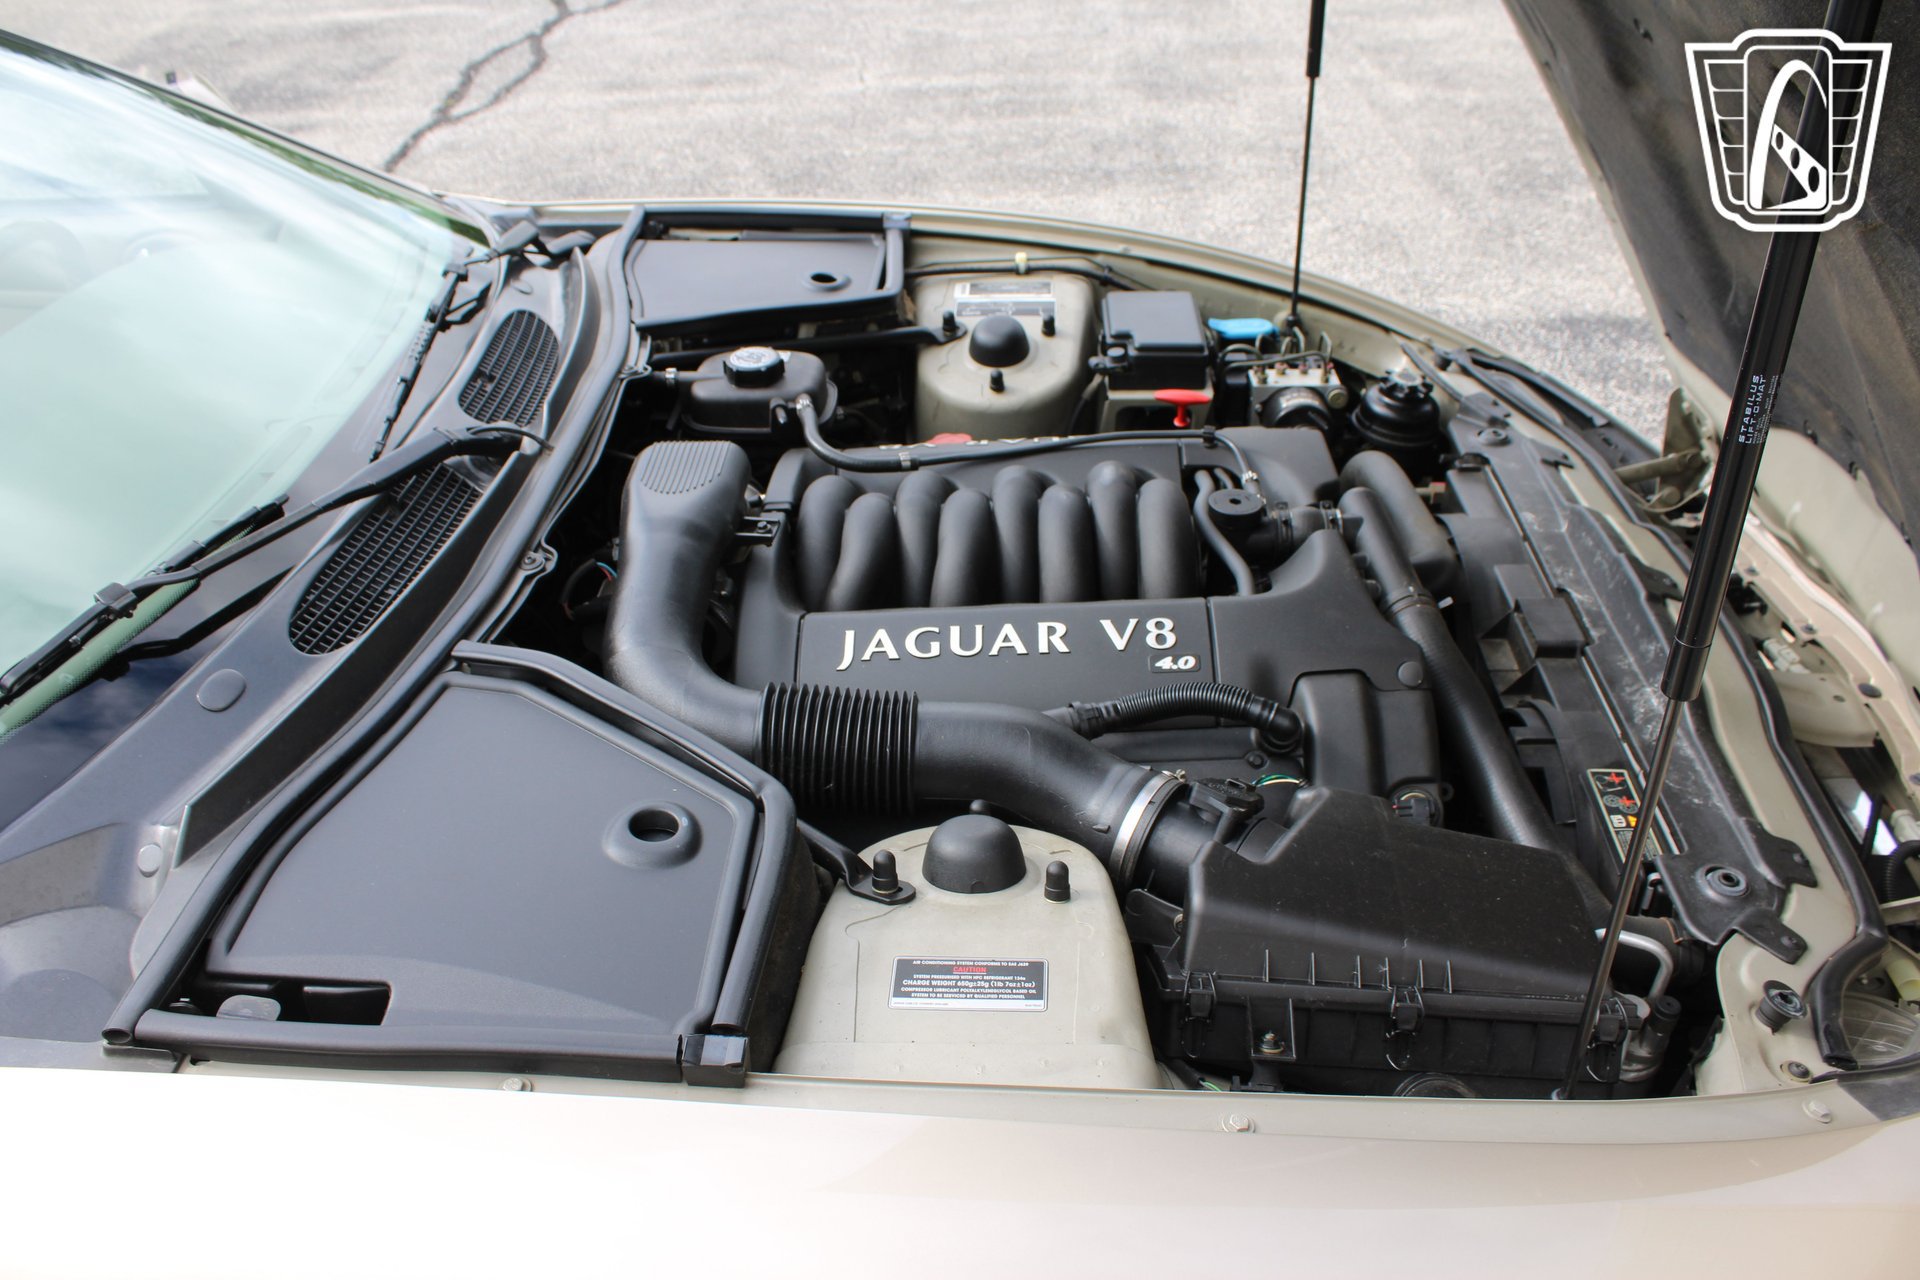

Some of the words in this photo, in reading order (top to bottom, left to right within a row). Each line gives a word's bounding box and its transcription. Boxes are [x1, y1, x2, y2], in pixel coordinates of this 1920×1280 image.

[1738, 375, 1759, 443] STABILUS
[836, 621, 1071, 672] JAGUAR
[1100, 617, 1178, 652] V8
[1153, 655, 1197, 670] 4.0
